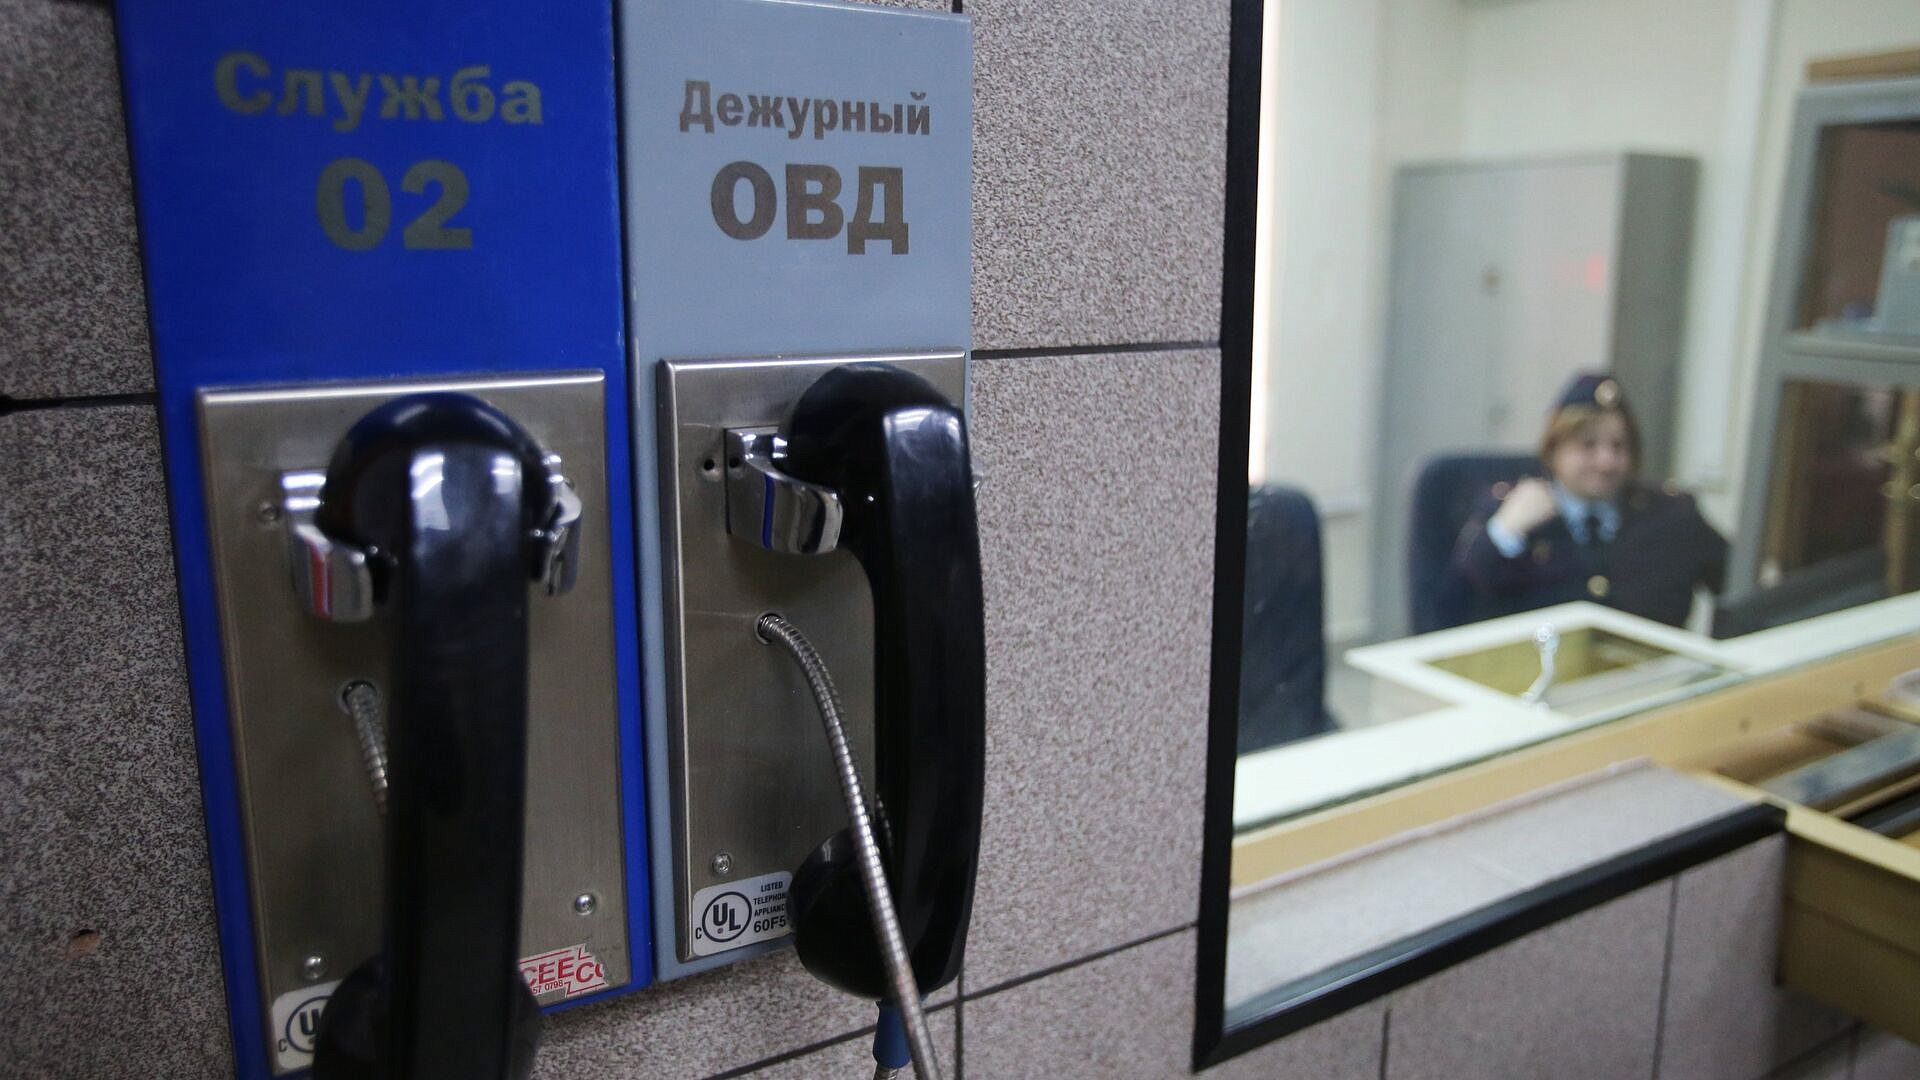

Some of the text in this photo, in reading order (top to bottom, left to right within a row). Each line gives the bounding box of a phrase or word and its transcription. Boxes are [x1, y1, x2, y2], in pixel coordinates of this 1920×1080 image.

[214, 50, 543, 132] Служба
[680, 80, 930, 140] Дежурный
[316, 157, 472, 251] 02
[711, 161, 909, 255] ОВД
[753, 892, 786, 905] TELEPHON
[754, 904, 785, 917] APPLIANC
[761, 881, 783, 892] LISTED
